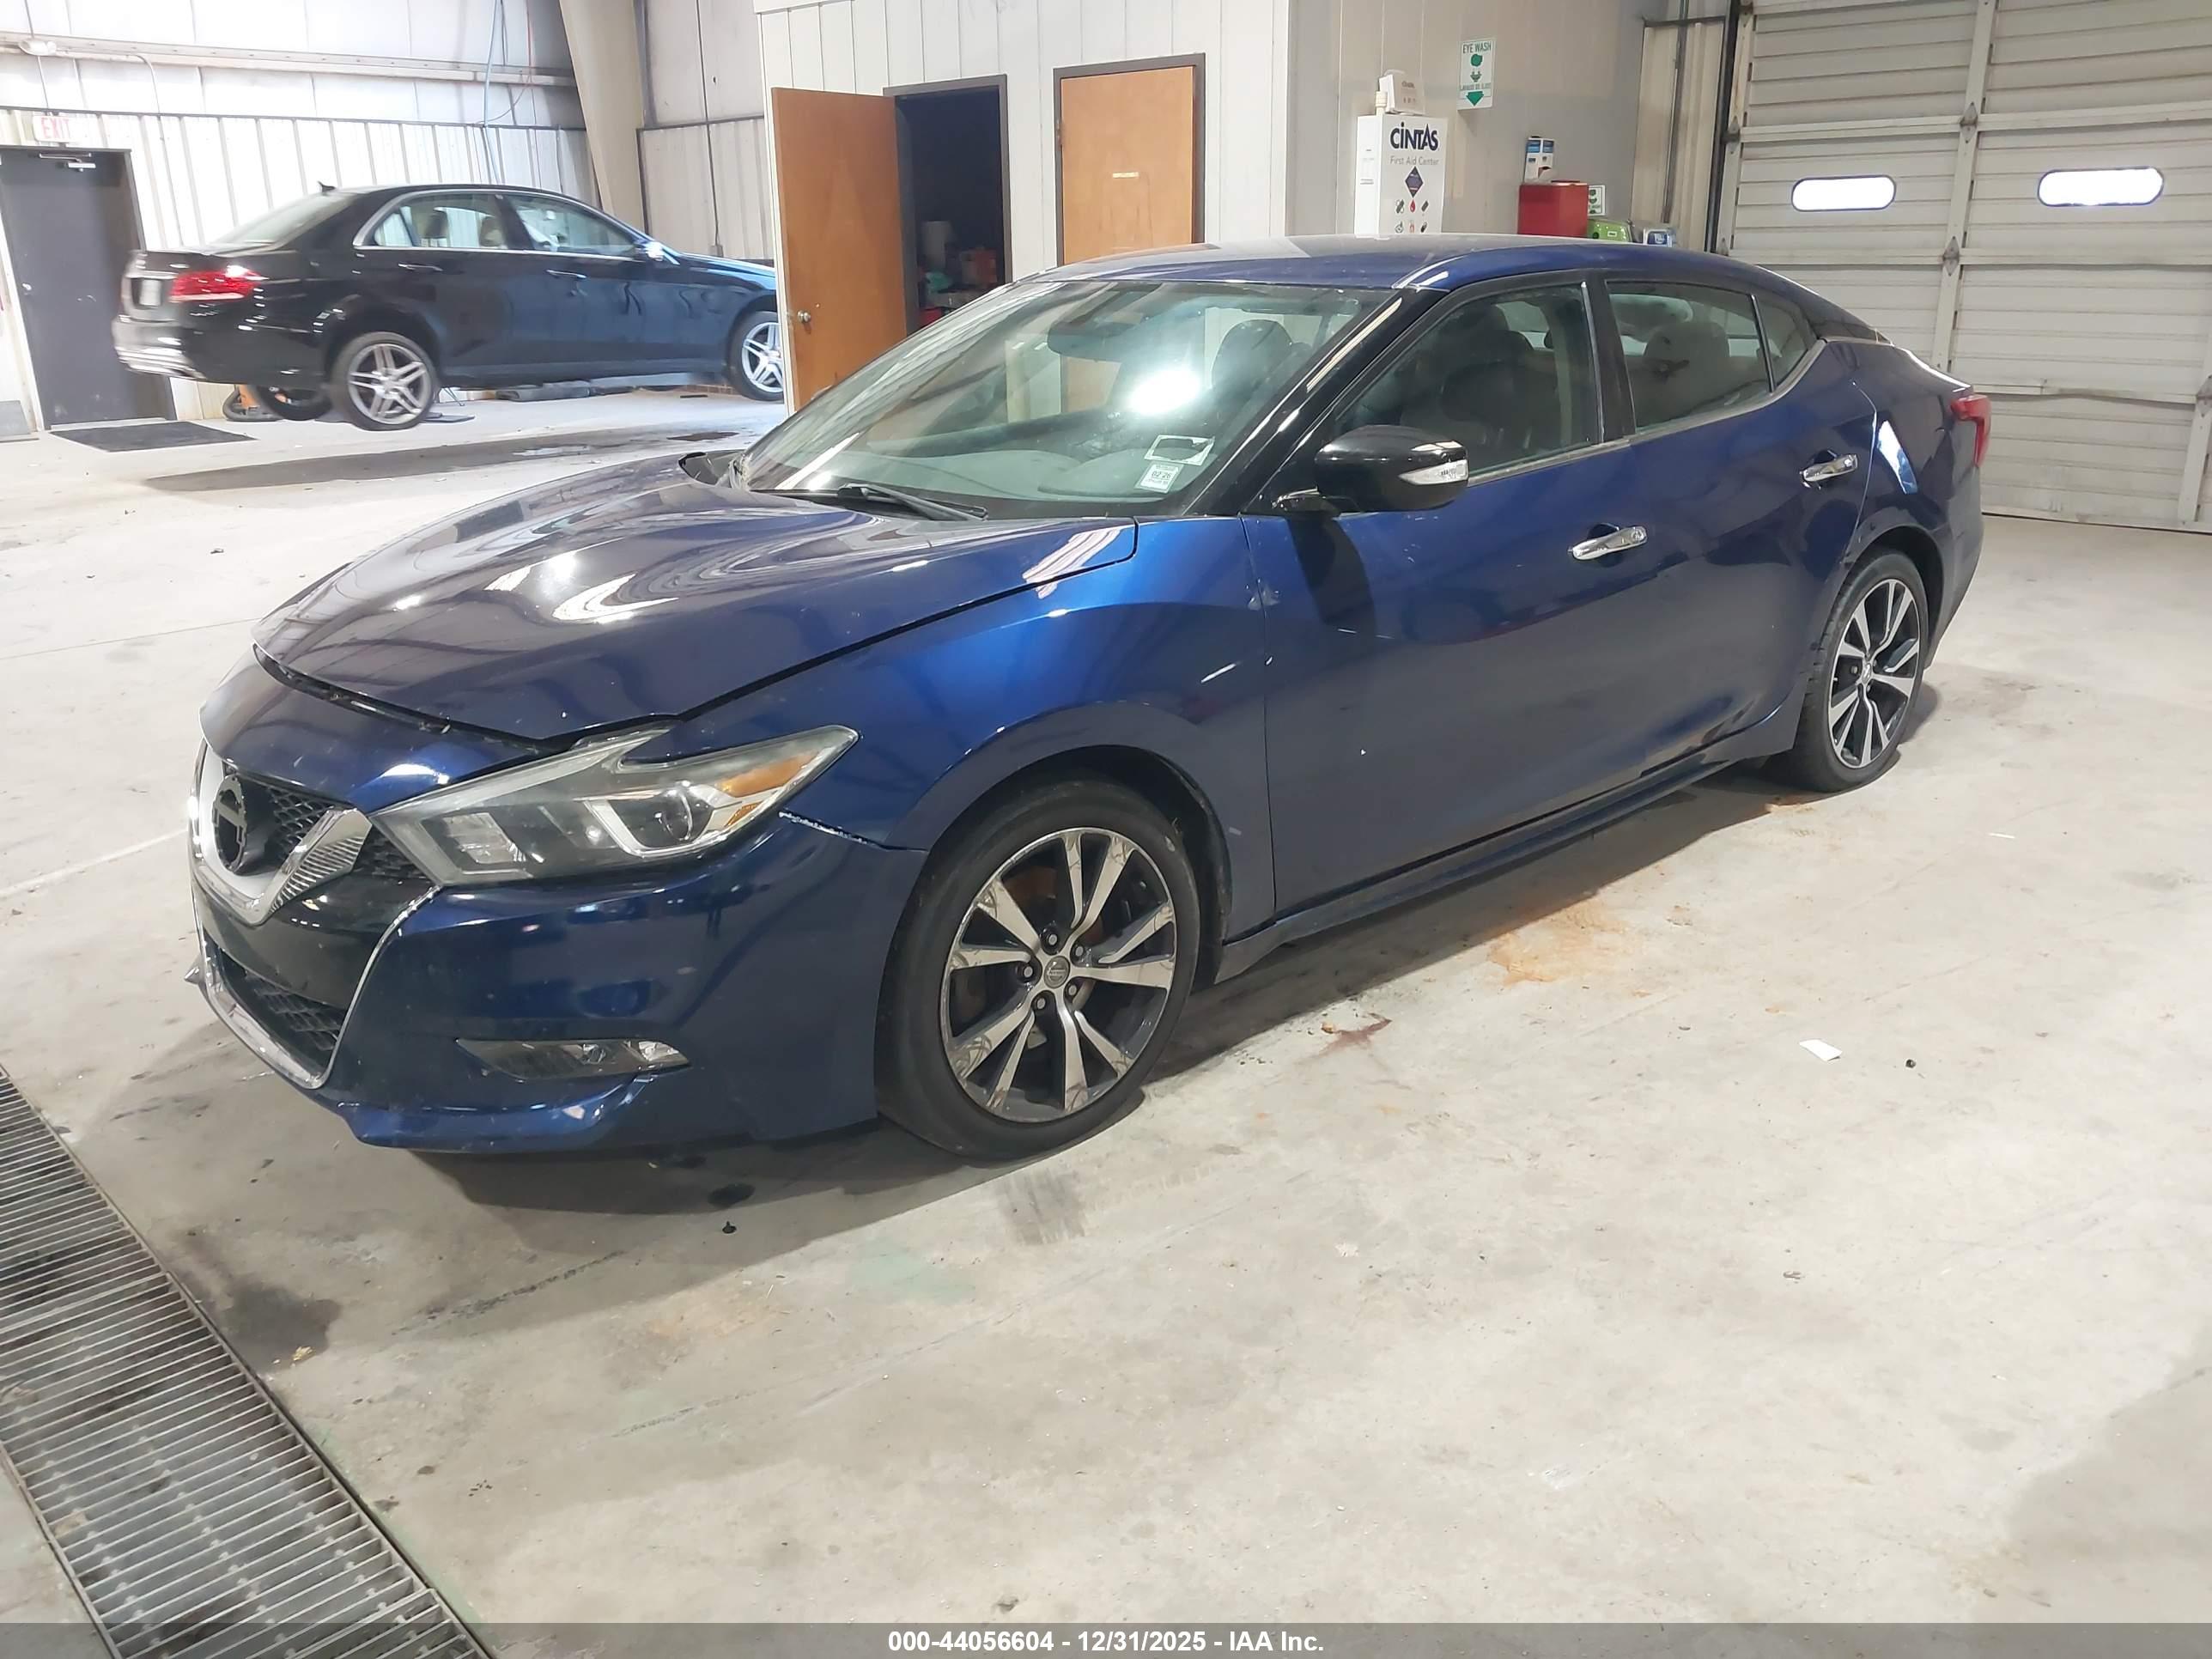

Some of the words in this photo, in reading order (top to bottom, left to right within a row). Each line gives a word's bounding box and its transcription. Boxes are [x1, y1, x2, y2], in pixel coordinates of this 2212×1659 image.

[1462, 43, 1474, 53] EYE
[1474, 41, 1492, 52] WASH
[41, 117, 70, 139] EXIT
[1390, 121, 1439, 151] CINTAS
[1390, 155, 1404, 165] First
[1406, 156, 1417, 166] Aid
[1419, 156, 1439, 166] Center
